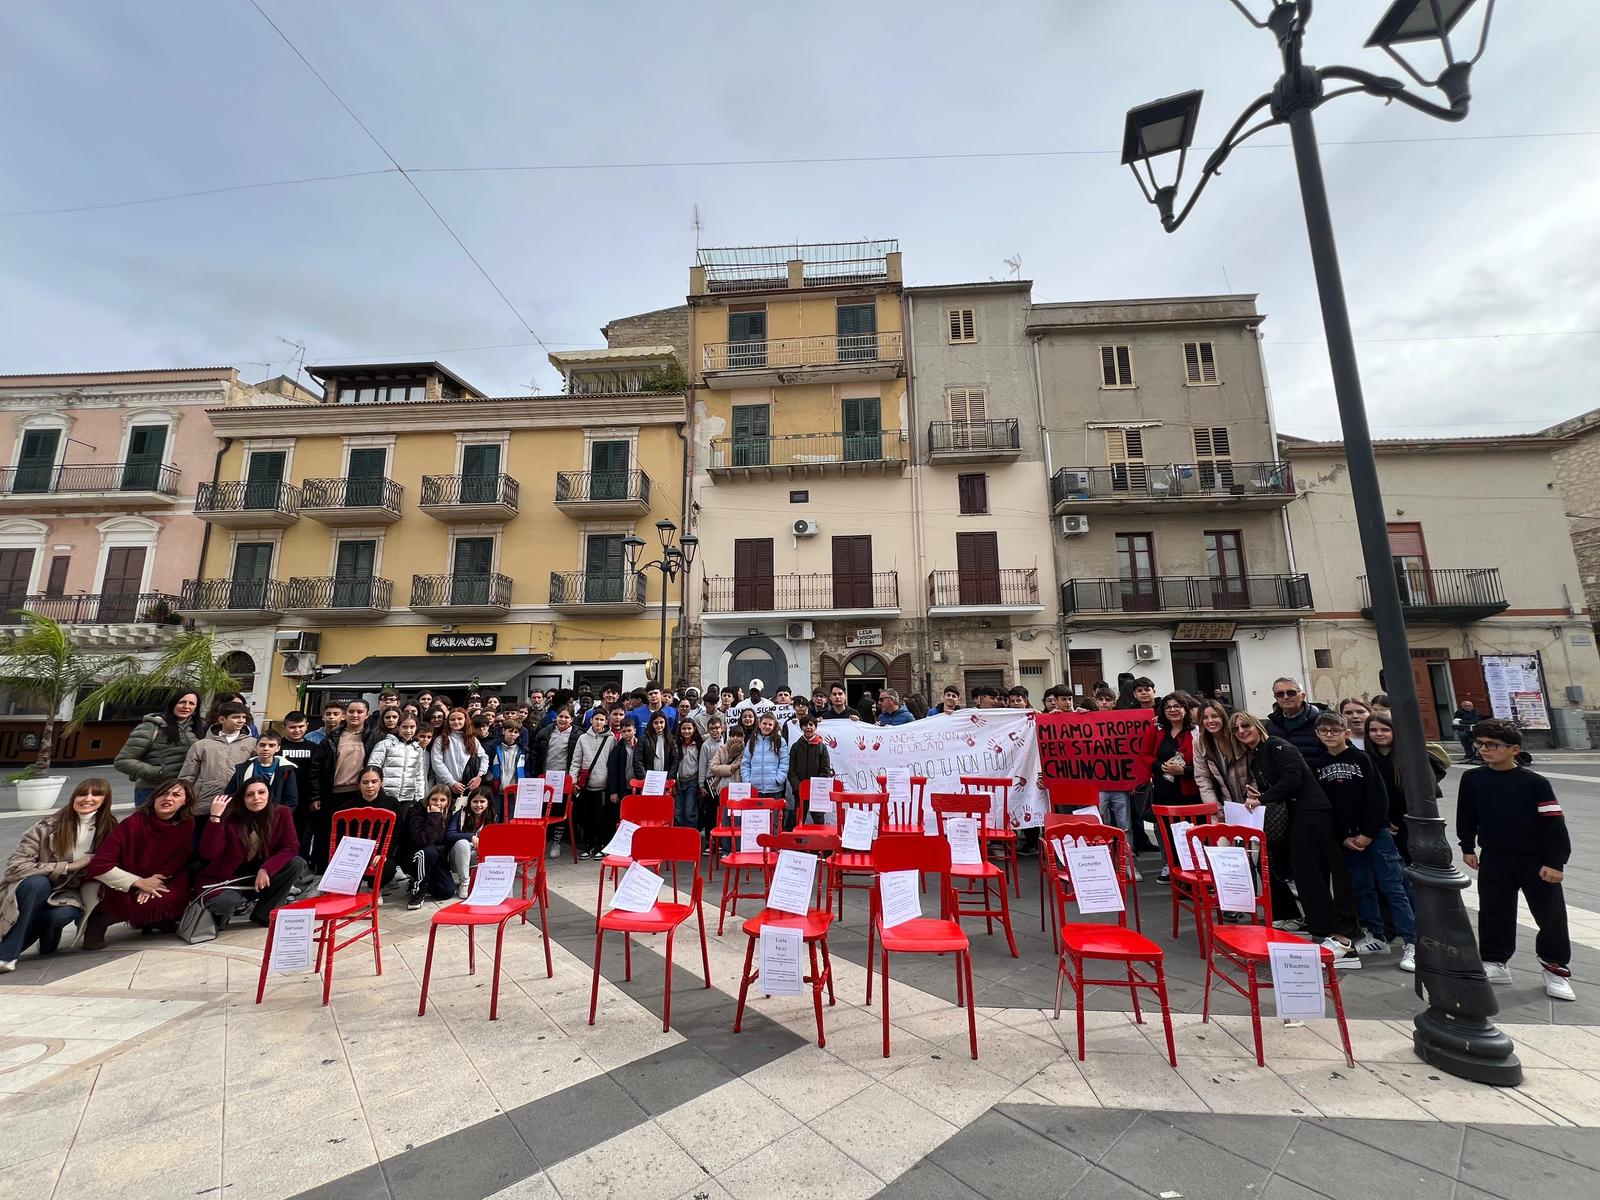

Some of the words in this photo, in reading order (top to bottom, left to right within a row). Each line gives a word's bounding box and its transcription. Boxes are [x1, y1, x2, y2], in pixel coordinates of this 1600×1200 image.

[430, 636, 494, 647] CARACAS
[890, 733, 916, 743] ANCHE
[924, 732, 934, 741] SE
[938, 731, 959, 741] NON
[282, 749, 311, 758] PUMA
[889, 744, 903, 755] HO
[908, 741, 944, 753] URLATO
[1039, 741, 1067, 757] PER
[1044, 759, 1136, 781] CHIUNQUE
